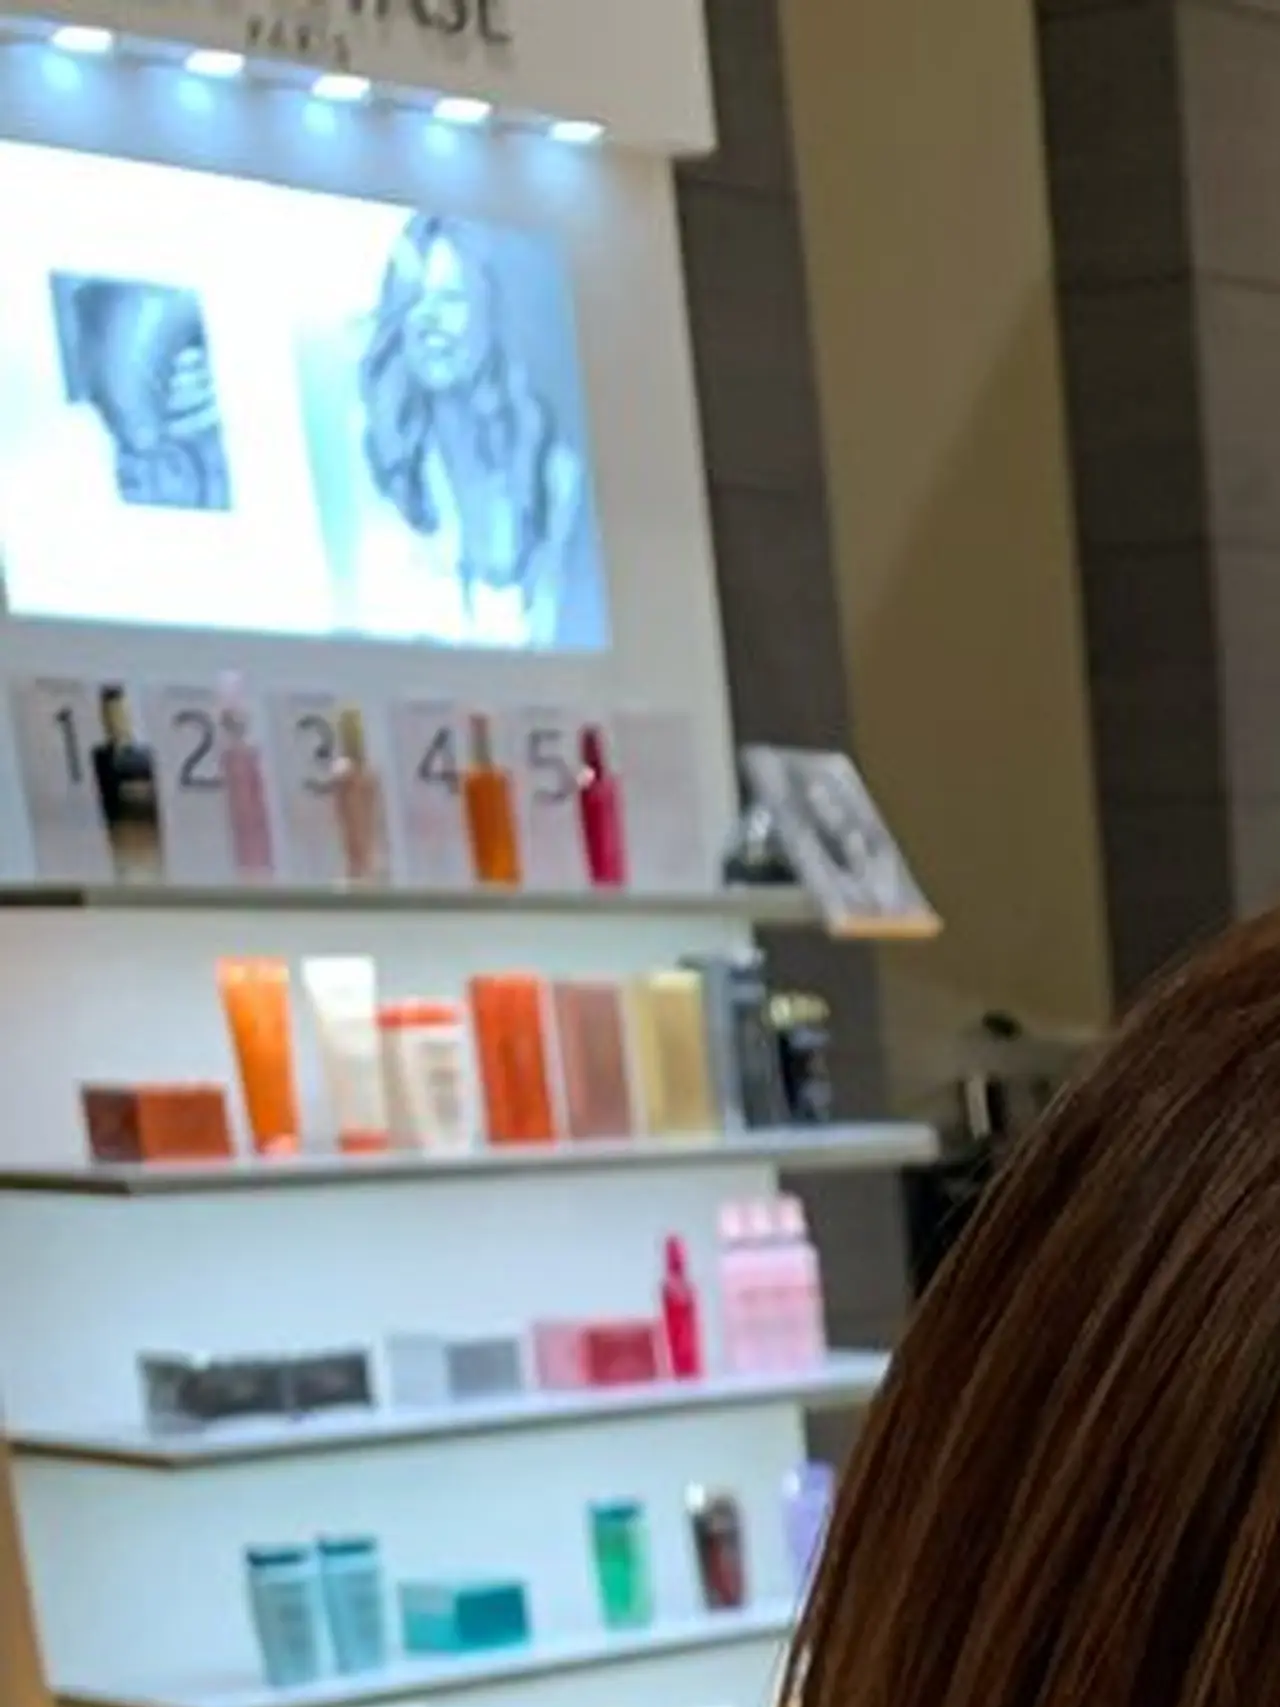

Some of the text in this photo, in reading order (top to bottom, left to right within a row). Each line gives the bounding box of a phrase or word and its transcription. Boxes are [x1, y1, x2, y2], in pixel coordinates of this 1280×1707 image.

[174, 708, 224, 790] 2
[296, 713, 338, 795] 3
[416, 726, 460, 796] 4
[527, 728, 580, 804] 5
